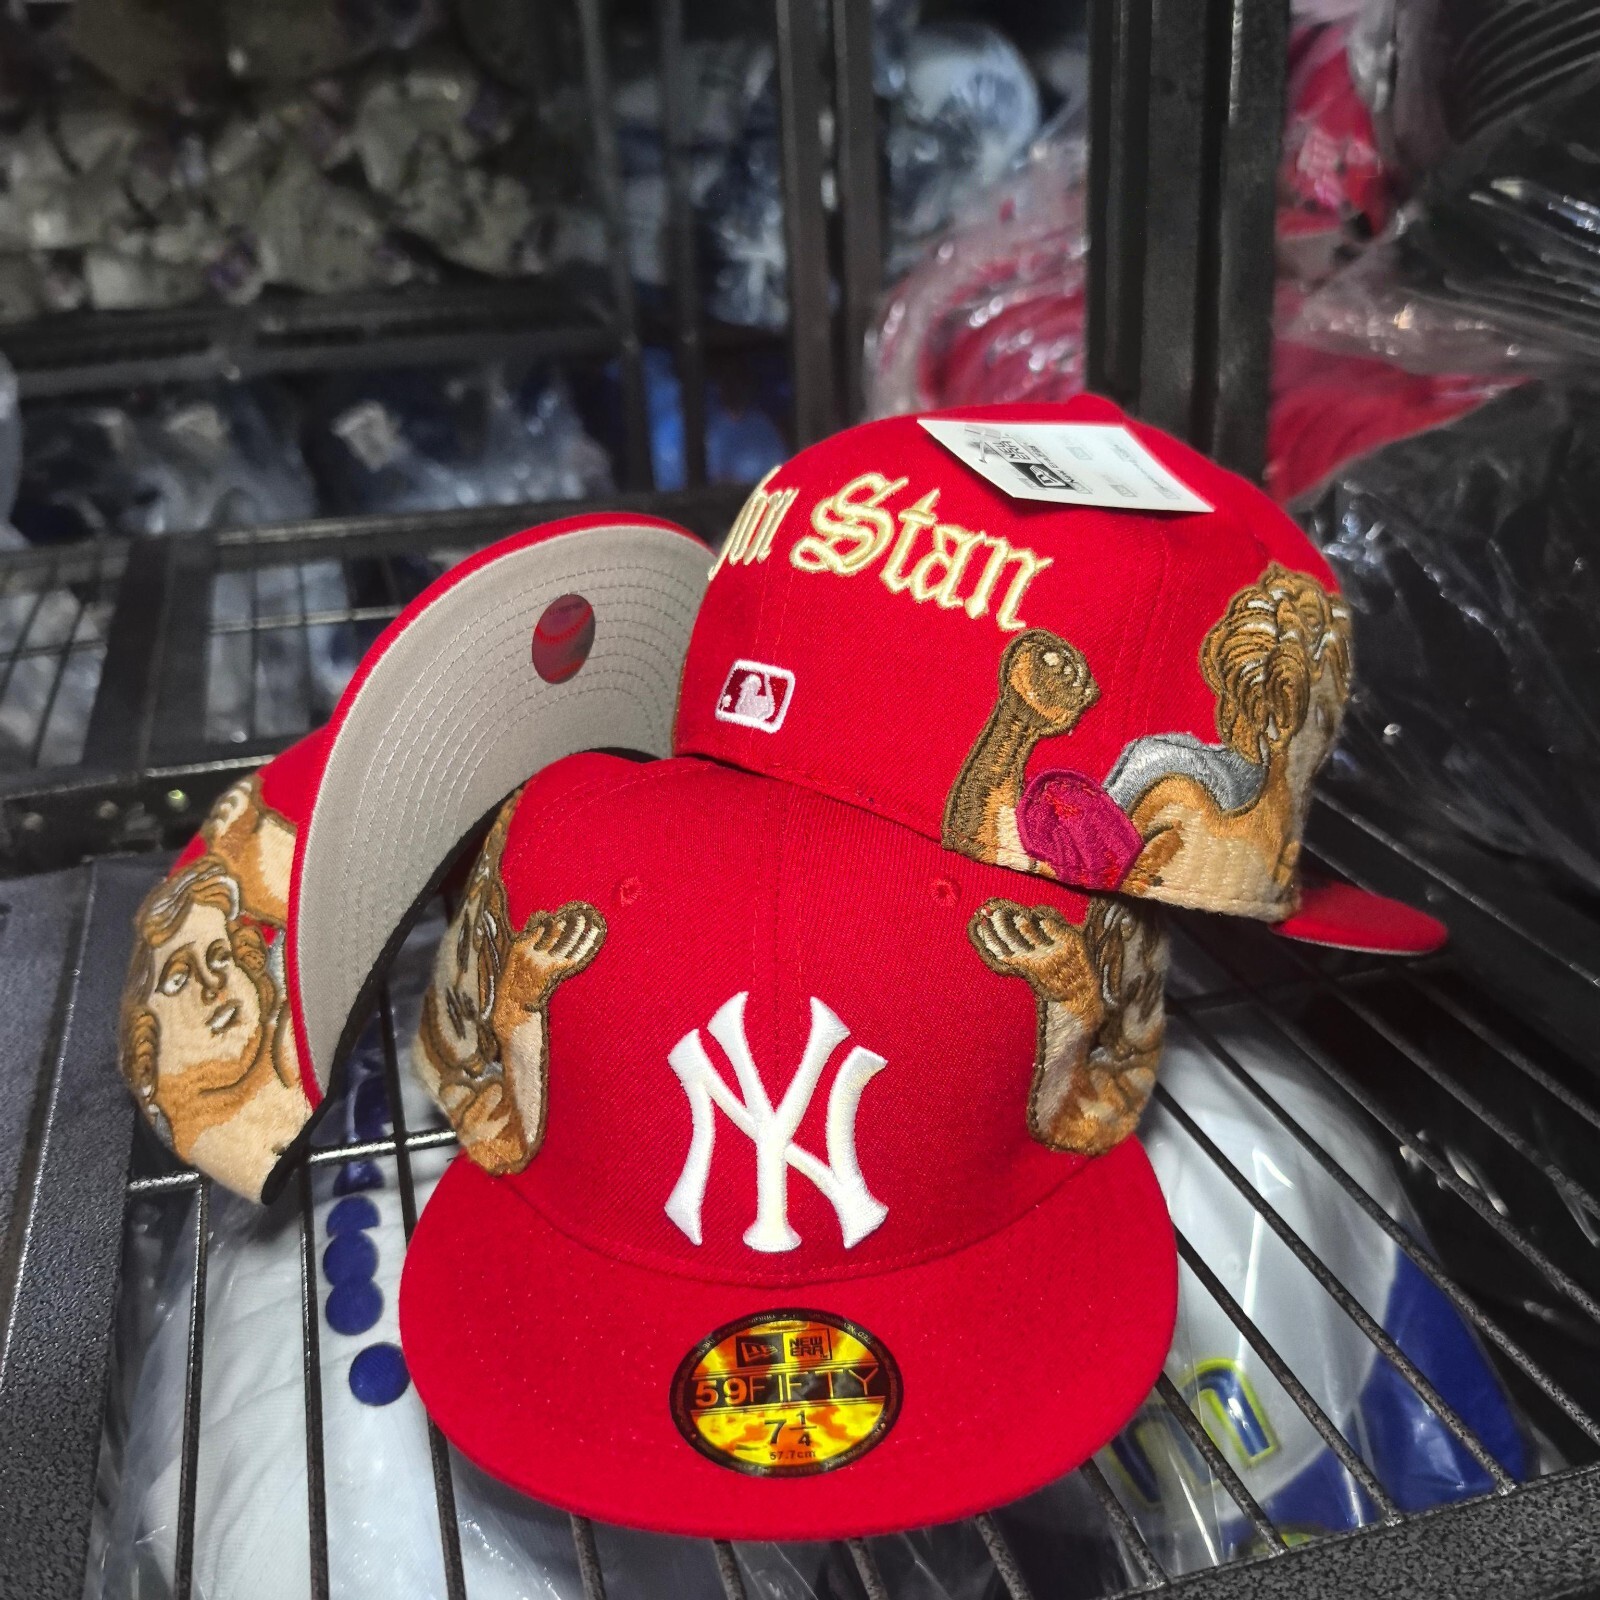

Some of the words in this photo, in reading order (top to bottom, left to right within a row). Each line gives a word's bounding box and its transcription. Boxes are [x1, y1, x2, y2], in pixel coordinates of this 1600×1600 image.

[789, 472, 1055, 631] Stan
[663, 990, 890, 1253] NY
[788, 1335, 823, 1348] NEW
[789, 1346, 824, 1357] ERA
[695, 1367, 879, 1407] 59FIFTY
[764, 1419, 787, 1445] 7
[769, 1450, 816, 1461] 57.7cm
